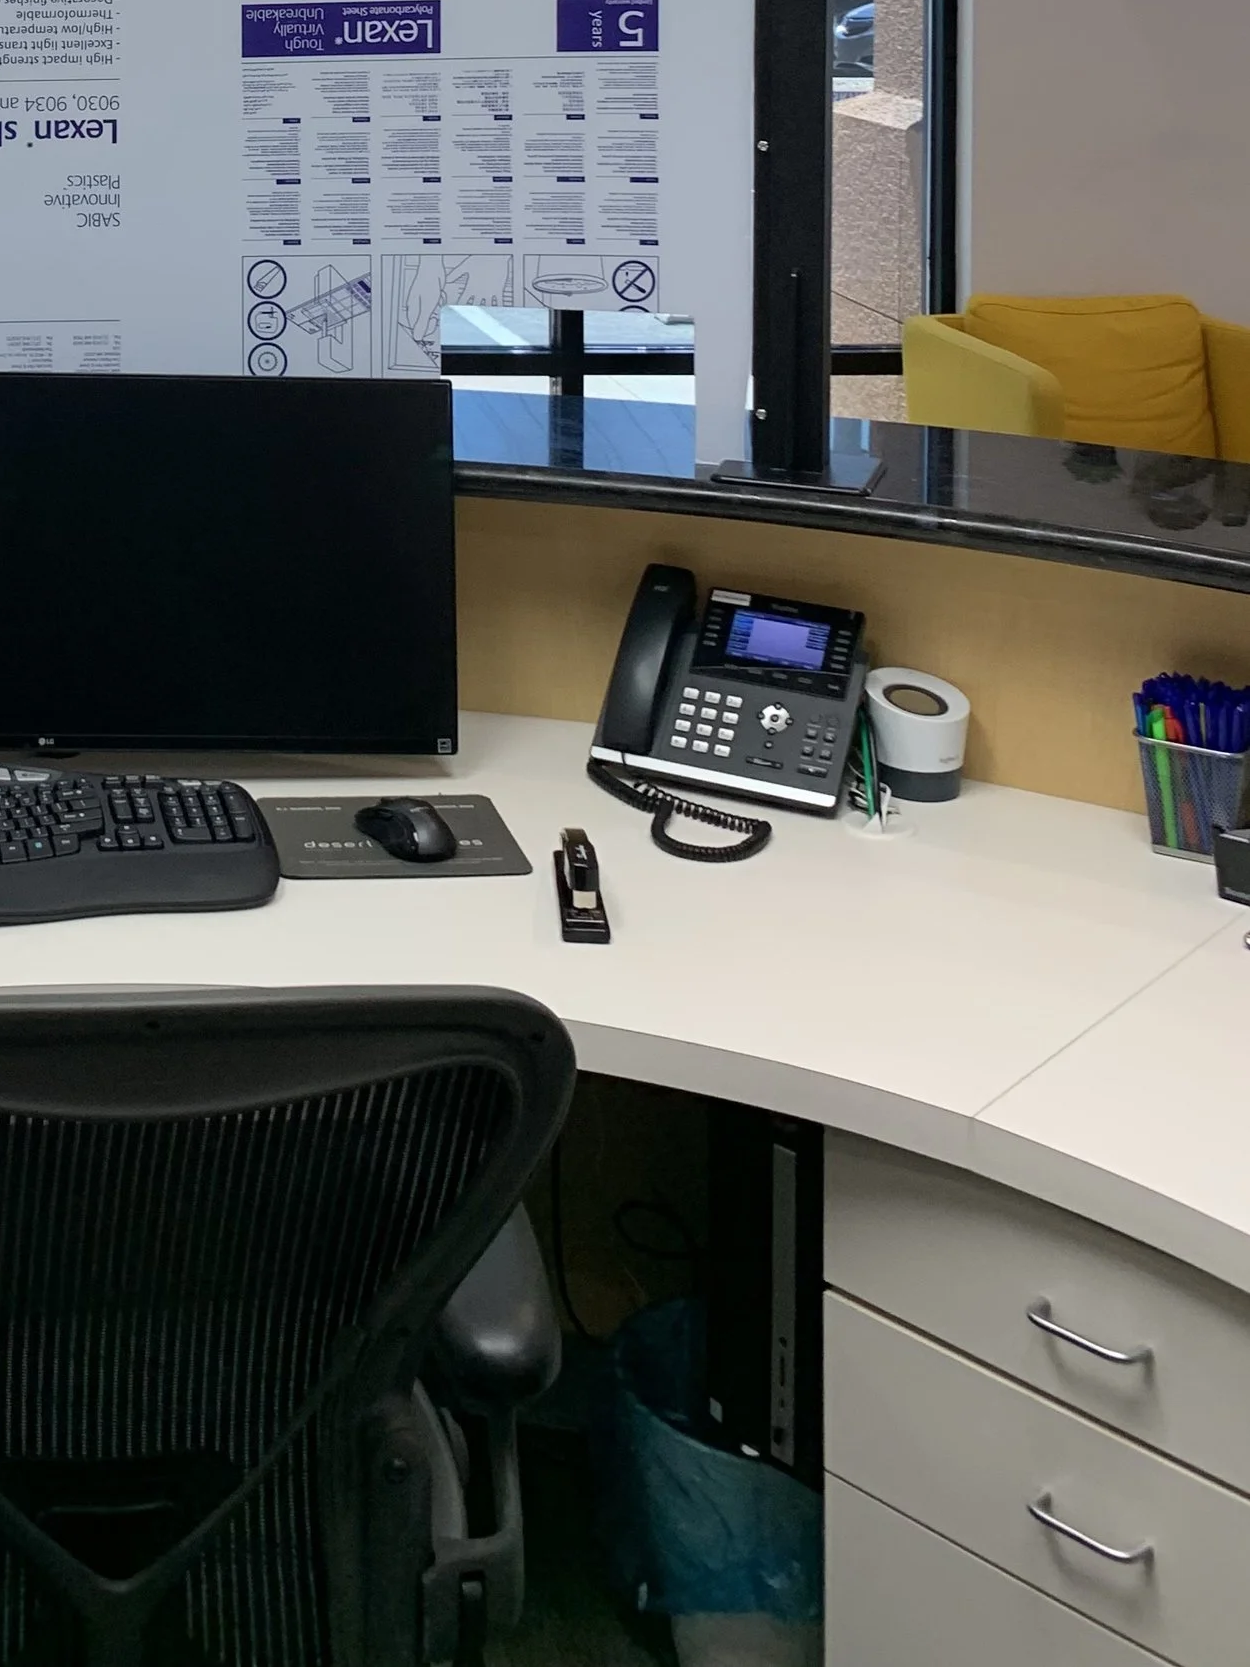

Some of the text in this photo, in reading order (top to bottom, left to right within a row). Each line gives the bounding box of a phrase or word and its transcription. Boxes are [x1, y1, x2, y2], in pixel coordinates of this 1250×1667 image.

[16, 10, 114, 23] Thermoformable
[246, 8, 325, 23] Unbreakable
[342, 4, 434, 16] Polycarbonate Sheet
[61, 20, 113, 35] High/low
[274, 20, 325, 38] Virtually
[589, 11, 603, 47] years
[619, 11, 645, 46] 5
[31, 38, 58, 51] light
[61, 40, 113, 50] Excellent
[284, 35, 325, 51] Tough
[42, 53, 83, 65] impact
[86, 52, 113, 65] High
[25, 96, 68, 112] 9034
[73, 94, 120, 111] 9030,
[44, 194, 121, 209] Innovative
[77, 213, 121, 227] SABIC
